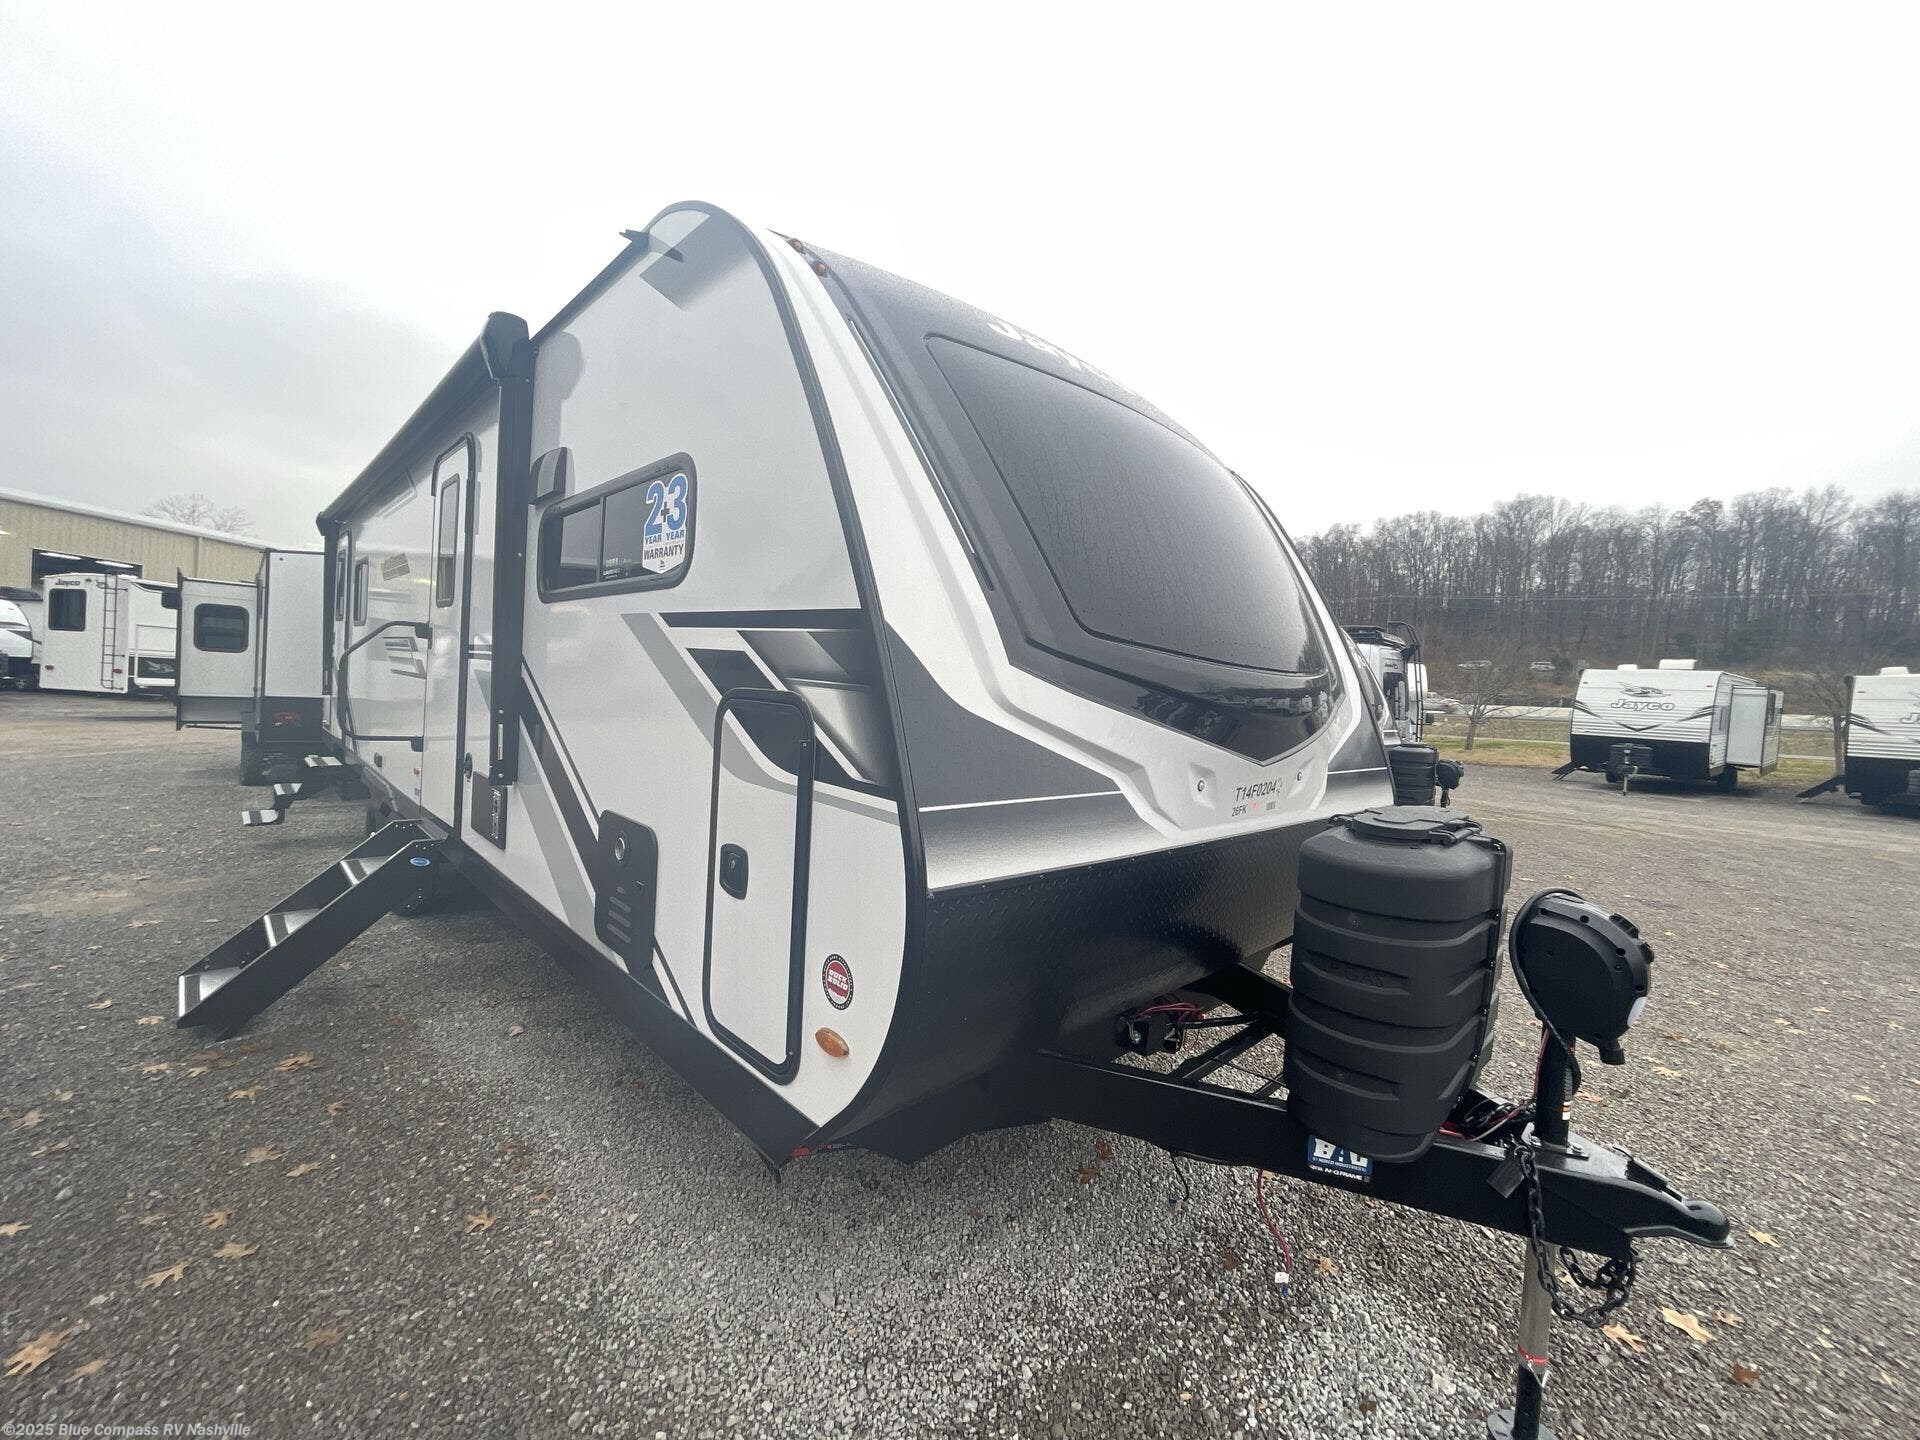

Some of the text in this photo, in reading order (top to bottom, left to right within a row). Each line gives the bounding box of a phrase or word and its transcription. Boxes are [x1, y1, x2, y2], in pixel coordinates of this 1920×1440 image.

[645, 529, 685, 545] YEAR YEAR
[644, 543, 684, 560] WARRANTY
[1610, 699, 1675, 711] Jayco
